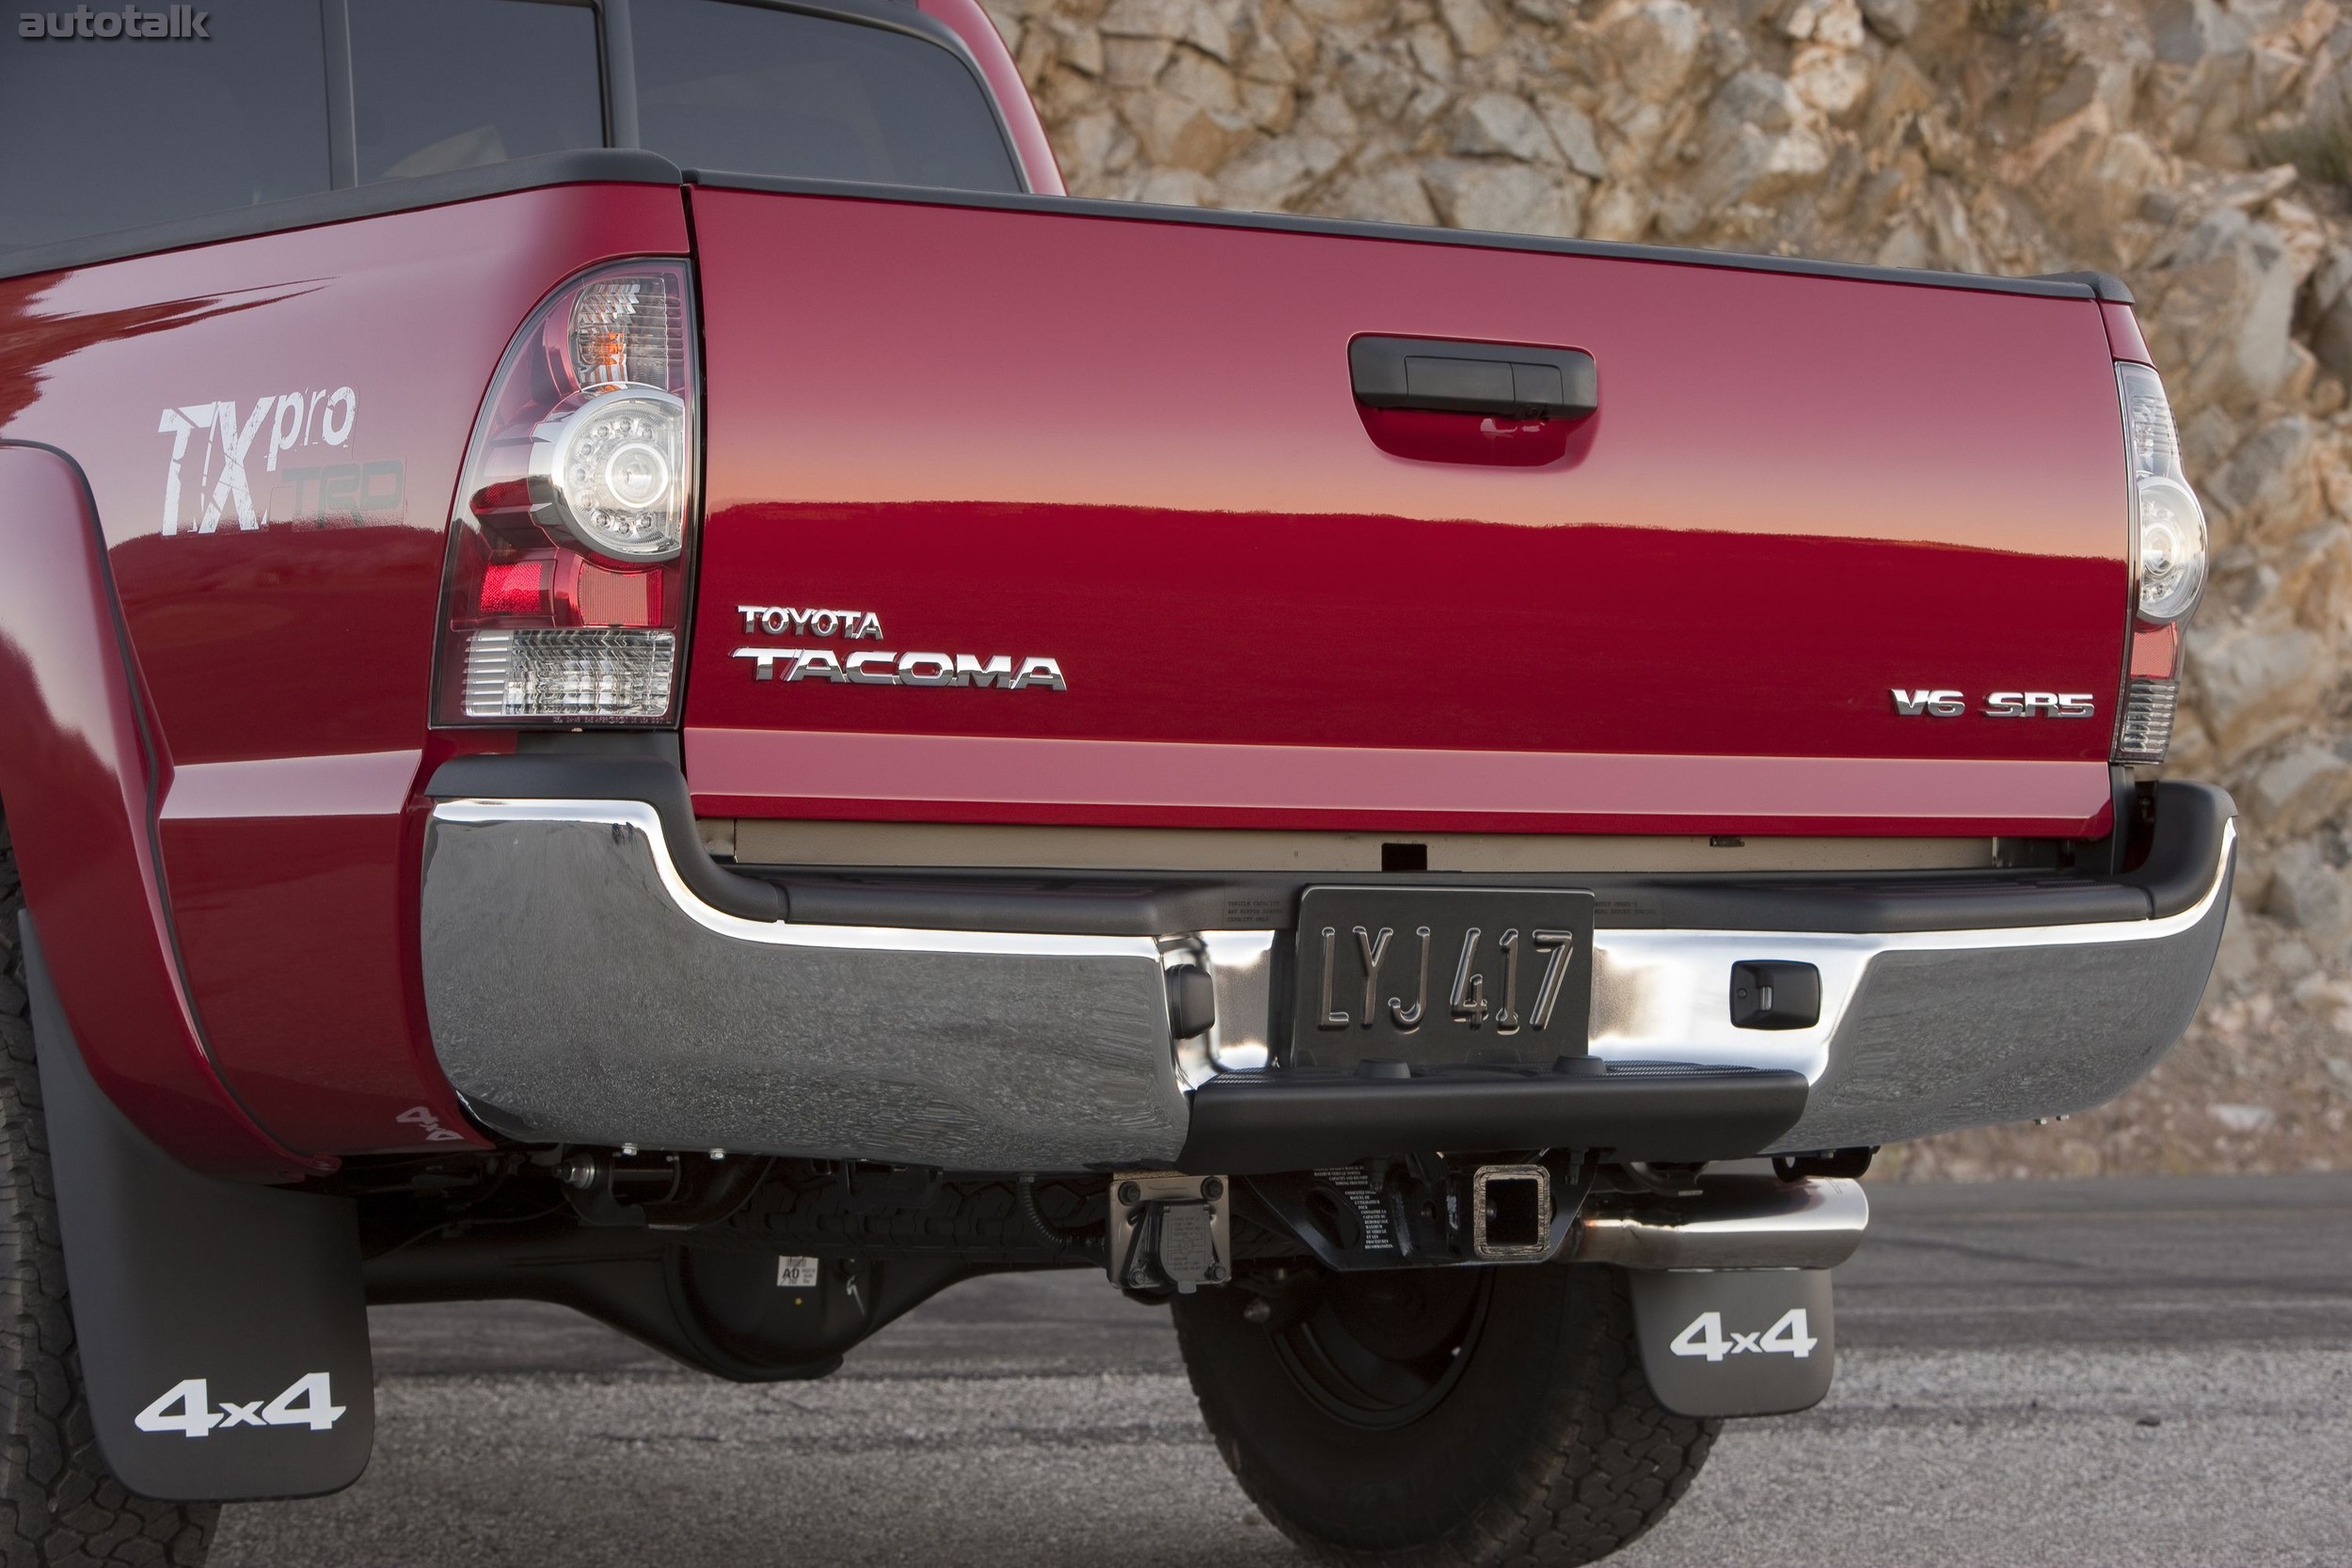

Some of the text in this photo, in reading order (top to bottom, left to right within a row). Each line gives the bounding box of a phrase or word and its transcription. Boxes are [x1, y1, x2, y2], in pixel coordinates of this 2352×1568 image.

[281, 458, 405, 529] TRD
[737, 604, 884, 641] TOYOTA
[729, 646, 1068, 692] TACOMA
[1890, 688, 2096, 719] V6 SR5
[1317, 926, 1574, 1036] LYJ 417
[1669, 1307, 1819, 1362] 4x4
[134, 1371, 347, 1438] 4x4
